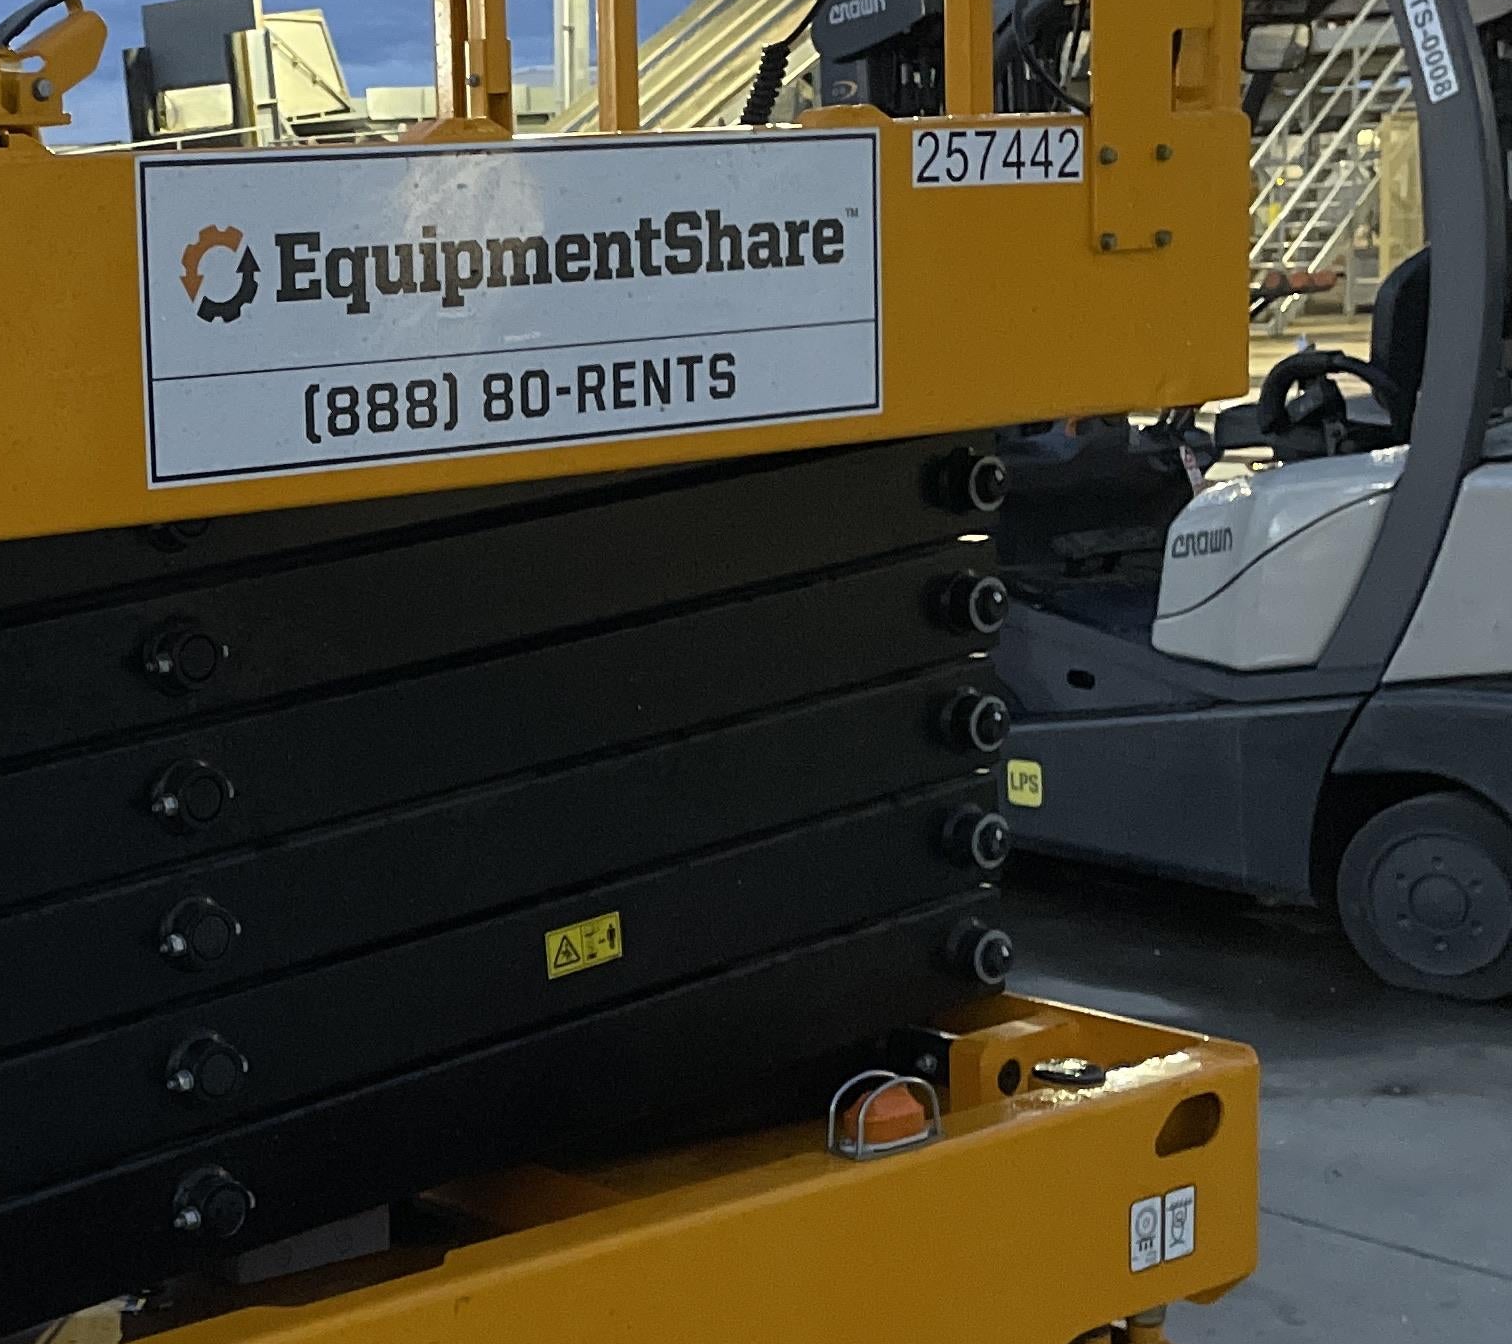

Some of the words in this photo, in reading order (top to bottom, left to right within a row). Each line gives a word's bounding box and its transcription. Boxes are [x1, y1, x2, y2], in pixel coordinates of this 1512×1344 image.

[917, 128, 1080, 184] 257442
[275, 210, 845, 315] EquipmentShare
[303, 373, 459, 445] (888)
[483, 353, 737, 423] 80-RENTS
[1010, 771, 1040, 794] LPS
